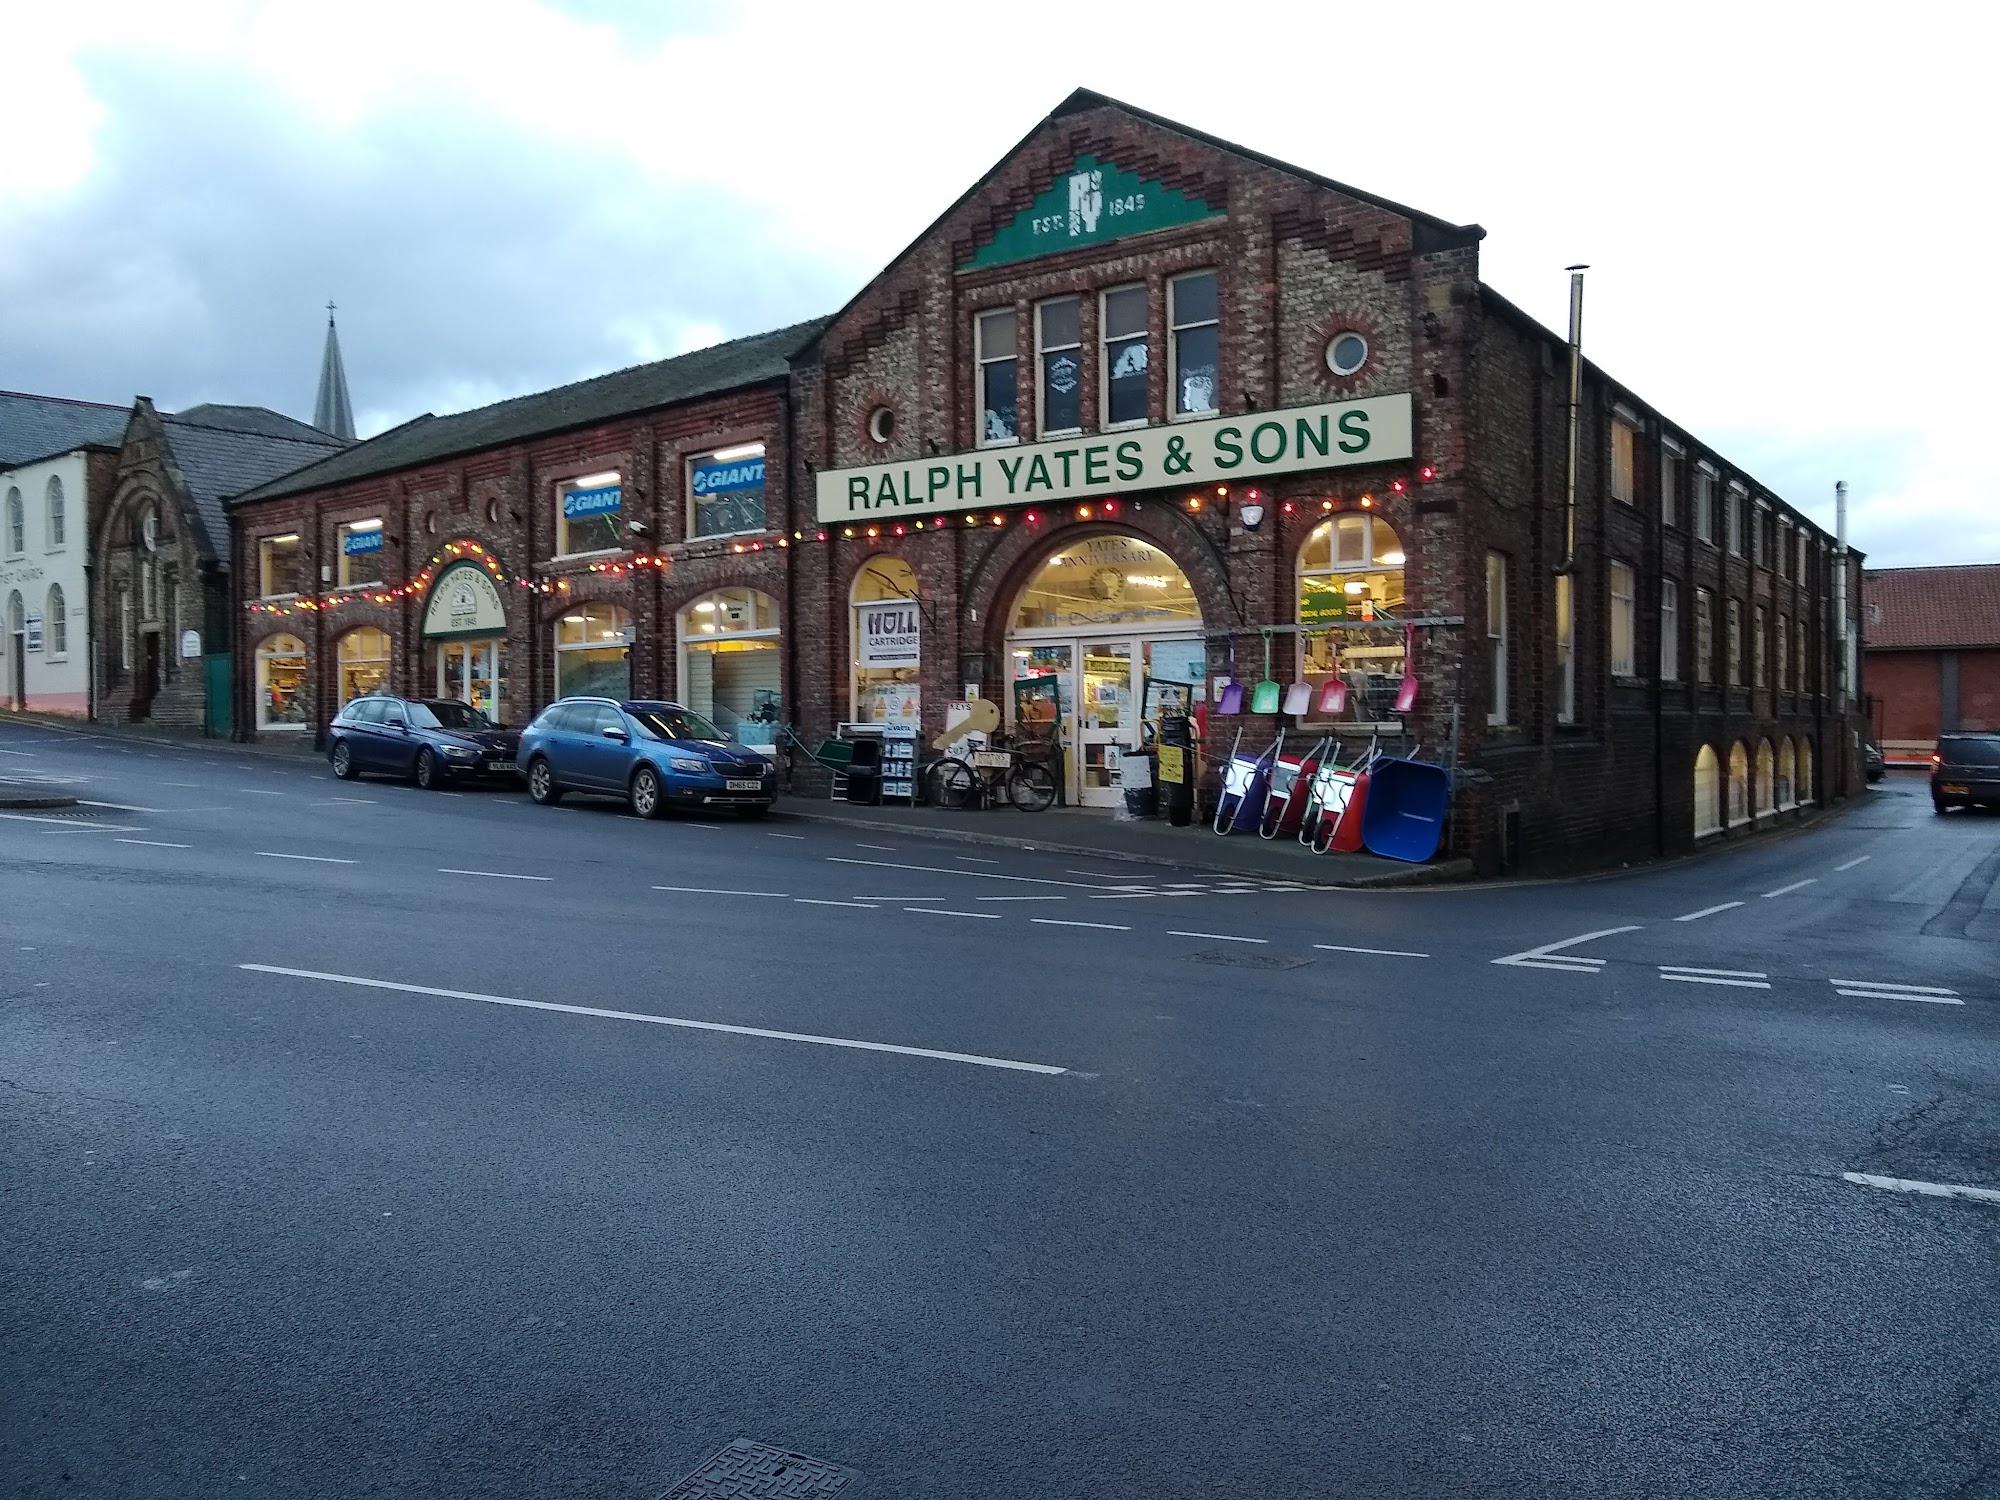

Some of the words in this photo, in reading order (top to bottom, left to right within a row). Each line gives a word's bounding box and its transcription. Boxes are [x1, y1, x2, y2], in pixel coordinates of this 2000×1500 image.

[848, 461, 982, 511] RALPH
[998, 441, 1144, 494] YATES
[1163, 435, 1194, 476] &
[1213, 409, 1372, 470] SONS
[707, 464, 765, 488] GIANT
[575, 491, 621, 511] GIANT
[868, 611, 918, 635] HULL
[868, 635, 918, 647] CARTRIDGE
[950, 703, 972, 711] KEYS
